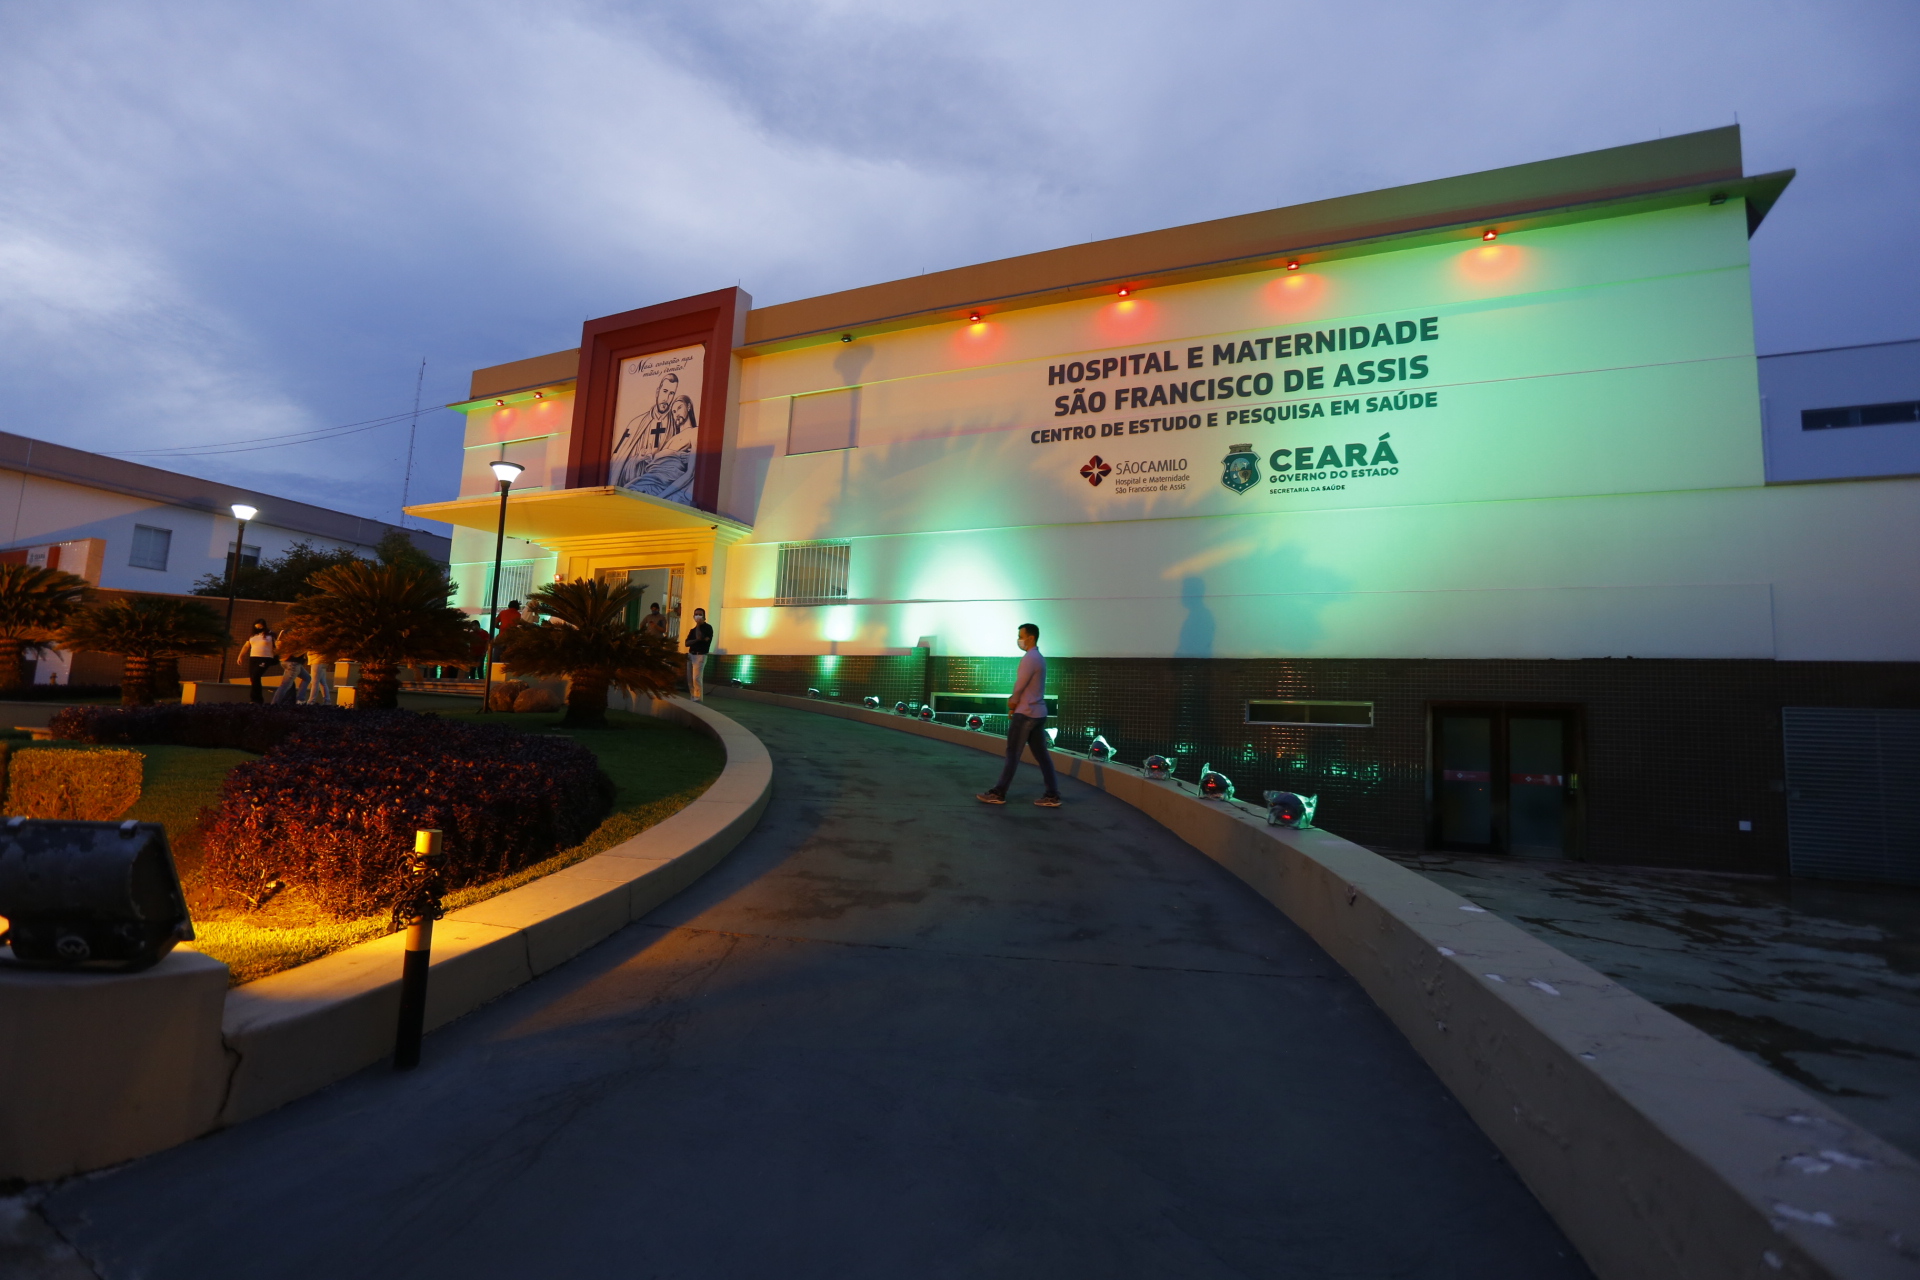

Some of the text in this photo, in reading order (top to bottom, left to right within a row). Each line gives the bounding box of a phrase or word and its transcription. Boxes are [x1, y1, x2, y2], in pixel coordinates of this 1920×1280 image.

[1048, 316, 1439, 386] HOSPITAL E MATERNIDADE
[1054, 355, 1429, 417] SÃO FRANCISCO DE ASSIS
[1031, 391, 1438, 444] CENTRO DE ESTUDO E PESQUISA EM SAÚDE
[1269, 432, 1399, 472] CEARÁ
[1115, 458, 1188, 475] SÃOCAMILO
[1269, 466, 1399, 484] GOVERNO DO ESTADO
[1115, 476, 1141, 486] Hospital
[1149, 474, 1190, 483] Maternidade
[1128, 485, 1158, 493] Francisco
[1269, 486, 1310, 494] SECRETARIA
